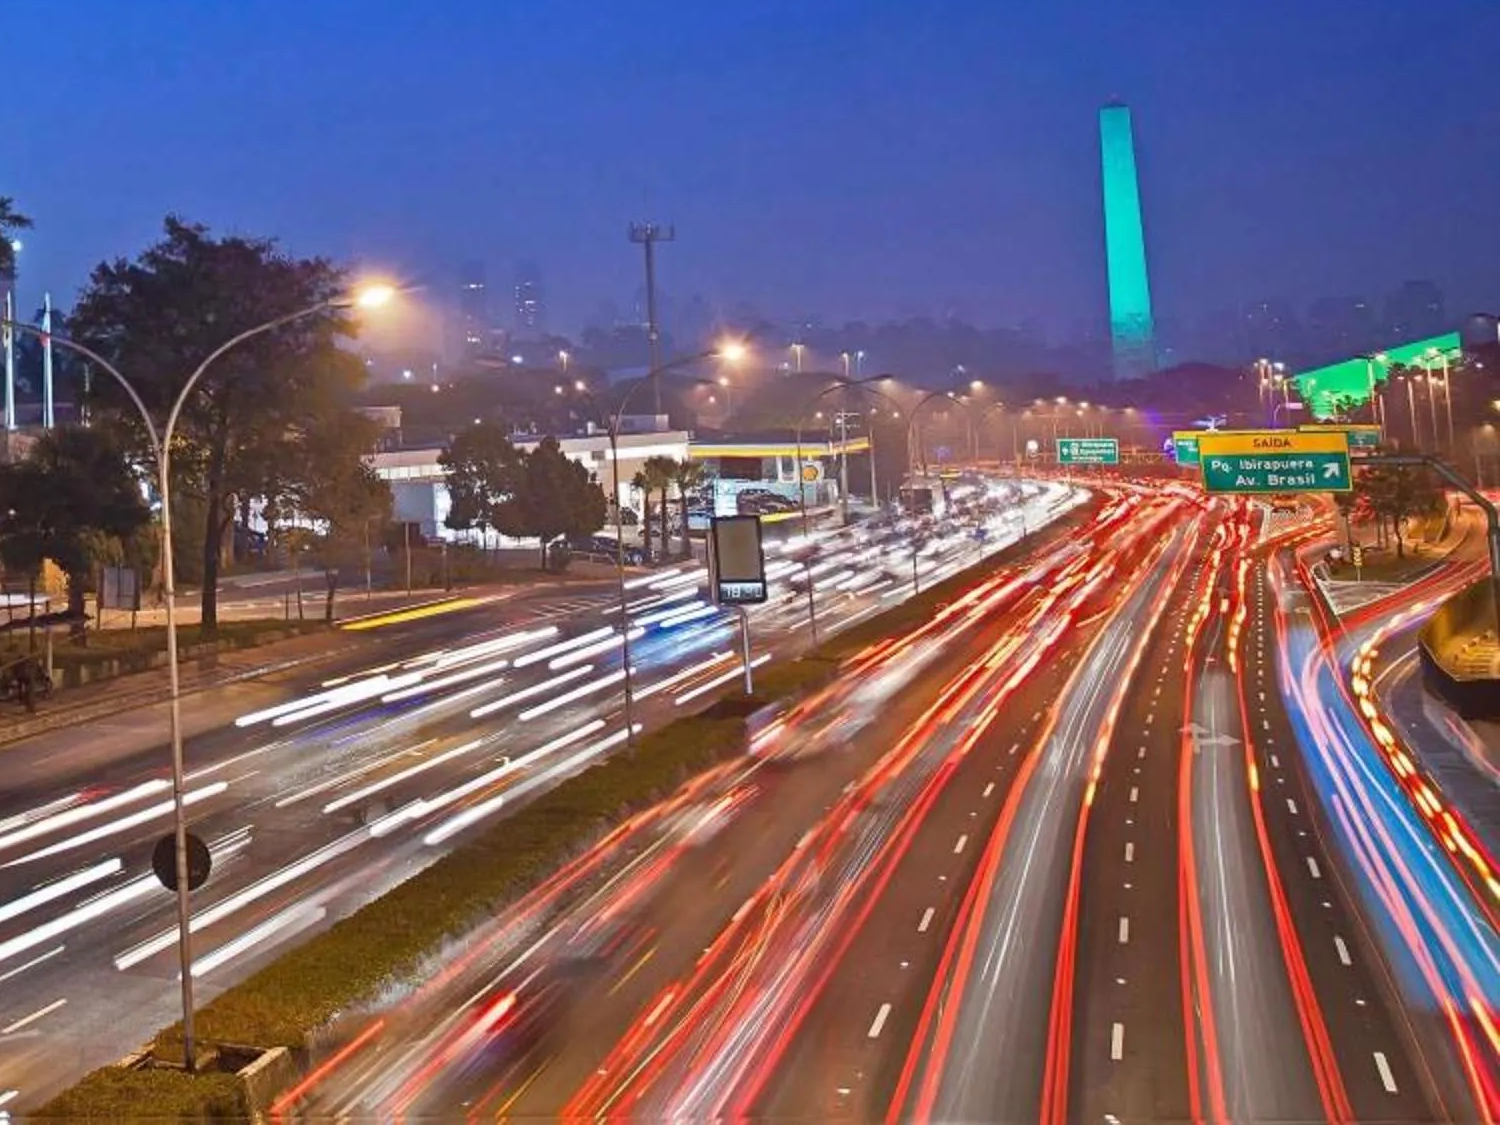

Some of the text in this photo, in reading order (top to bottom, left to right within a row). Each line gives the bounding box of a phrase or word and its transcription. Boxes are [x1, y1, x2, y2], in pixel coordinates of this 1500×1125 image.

[1253, 436, 1292, 448] SAÍDA
[1211, 459, 1314, 473] Pq. Ibirapuera
[1235, 474, 1316, 486] Av. Brasil
